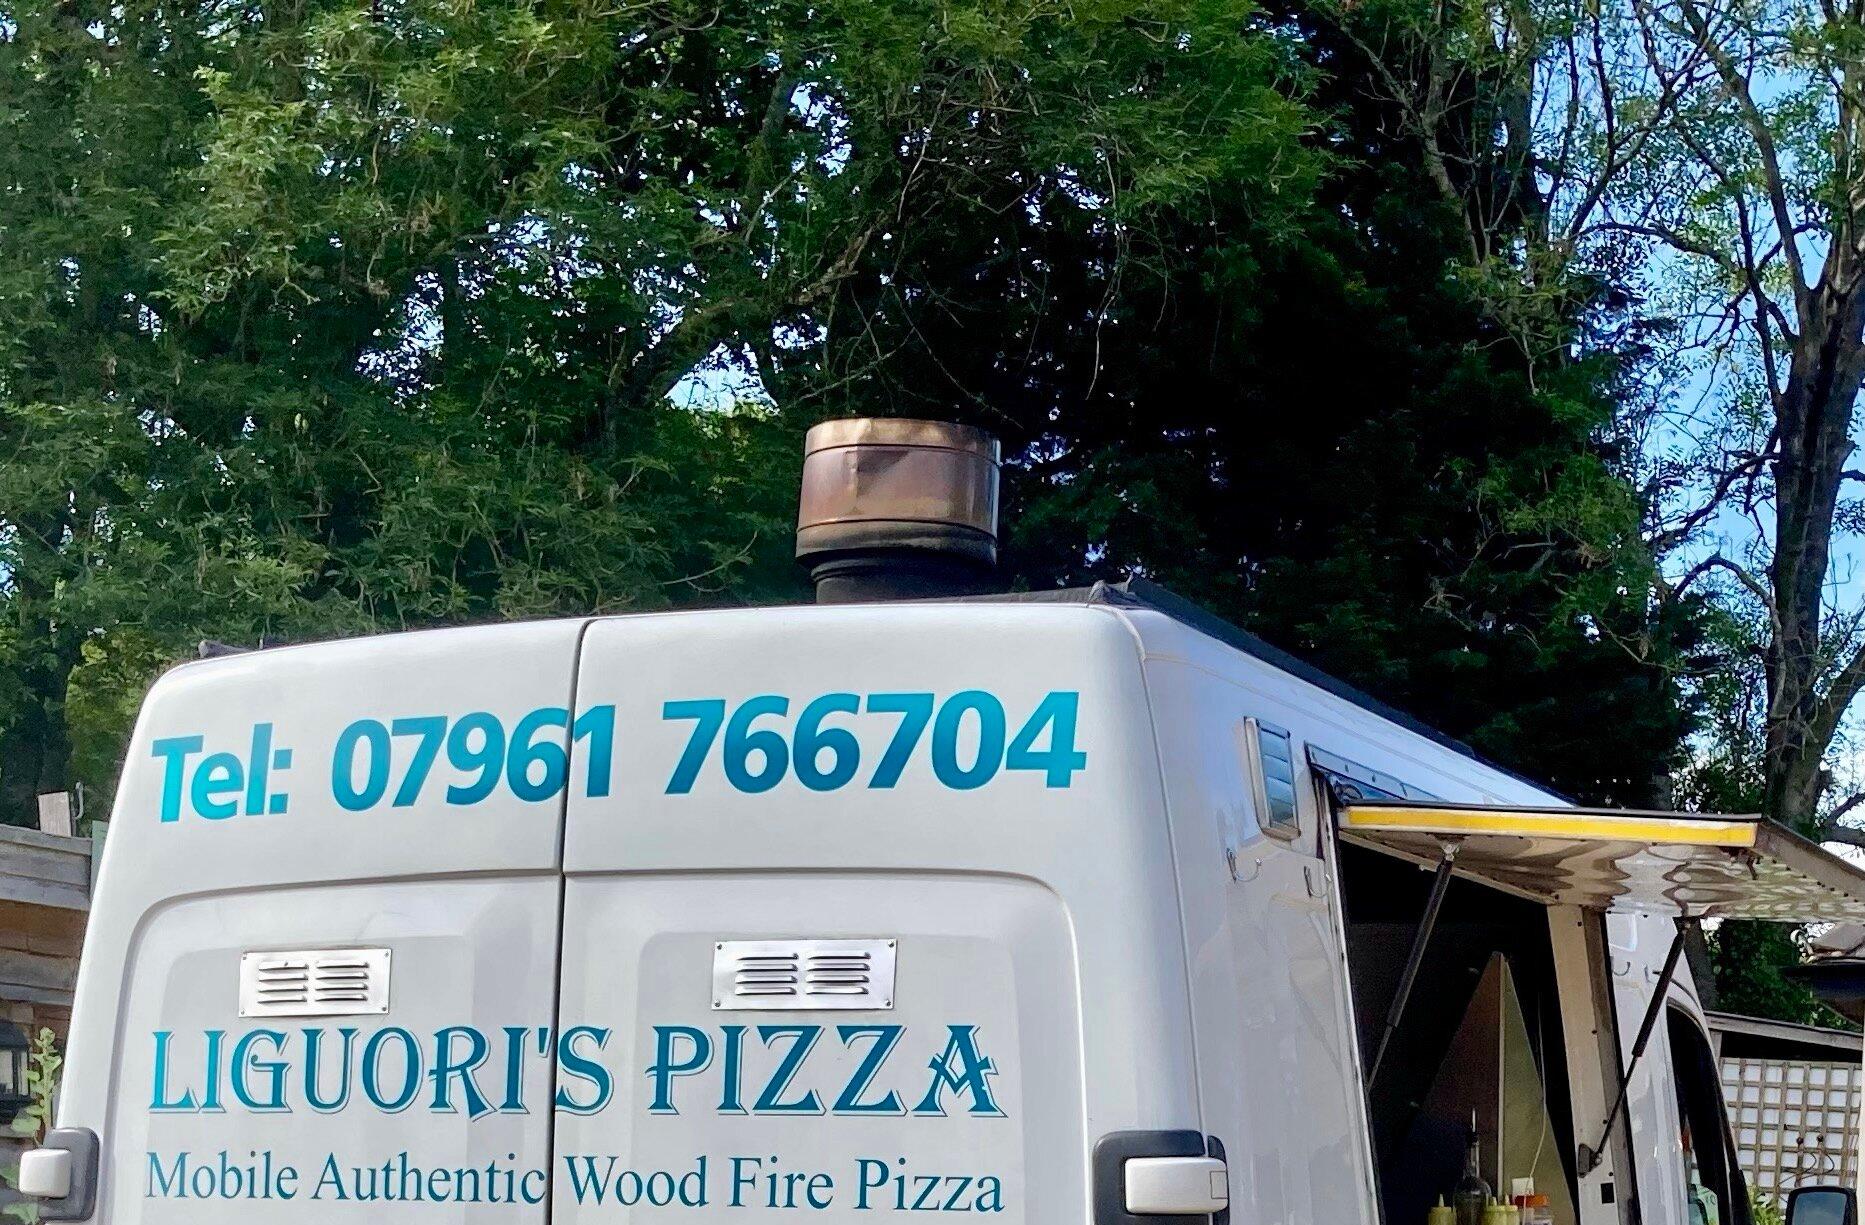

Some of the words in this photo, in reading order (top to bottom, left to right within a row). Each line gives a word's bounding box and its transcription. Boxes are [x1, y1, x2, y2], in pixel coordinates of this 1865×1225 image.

[151, 722, 292, 824] Tel:
[331, 704, 616, 812] 07961
[661, 690, 1088, 796] 766704
[148, 1025, 614, 1121] LIGUORI'S
[650, 1023, 1008, 1119] PIZZA
[145, 1150, 298, 1201] Mobile
[311, 1151, 547, 1206] Authentic
[565, 1155, 709, 1208] Wood
[729, 1155, 834, 1211] Fire
[856, 1157, 1005, 1213] Pizza
